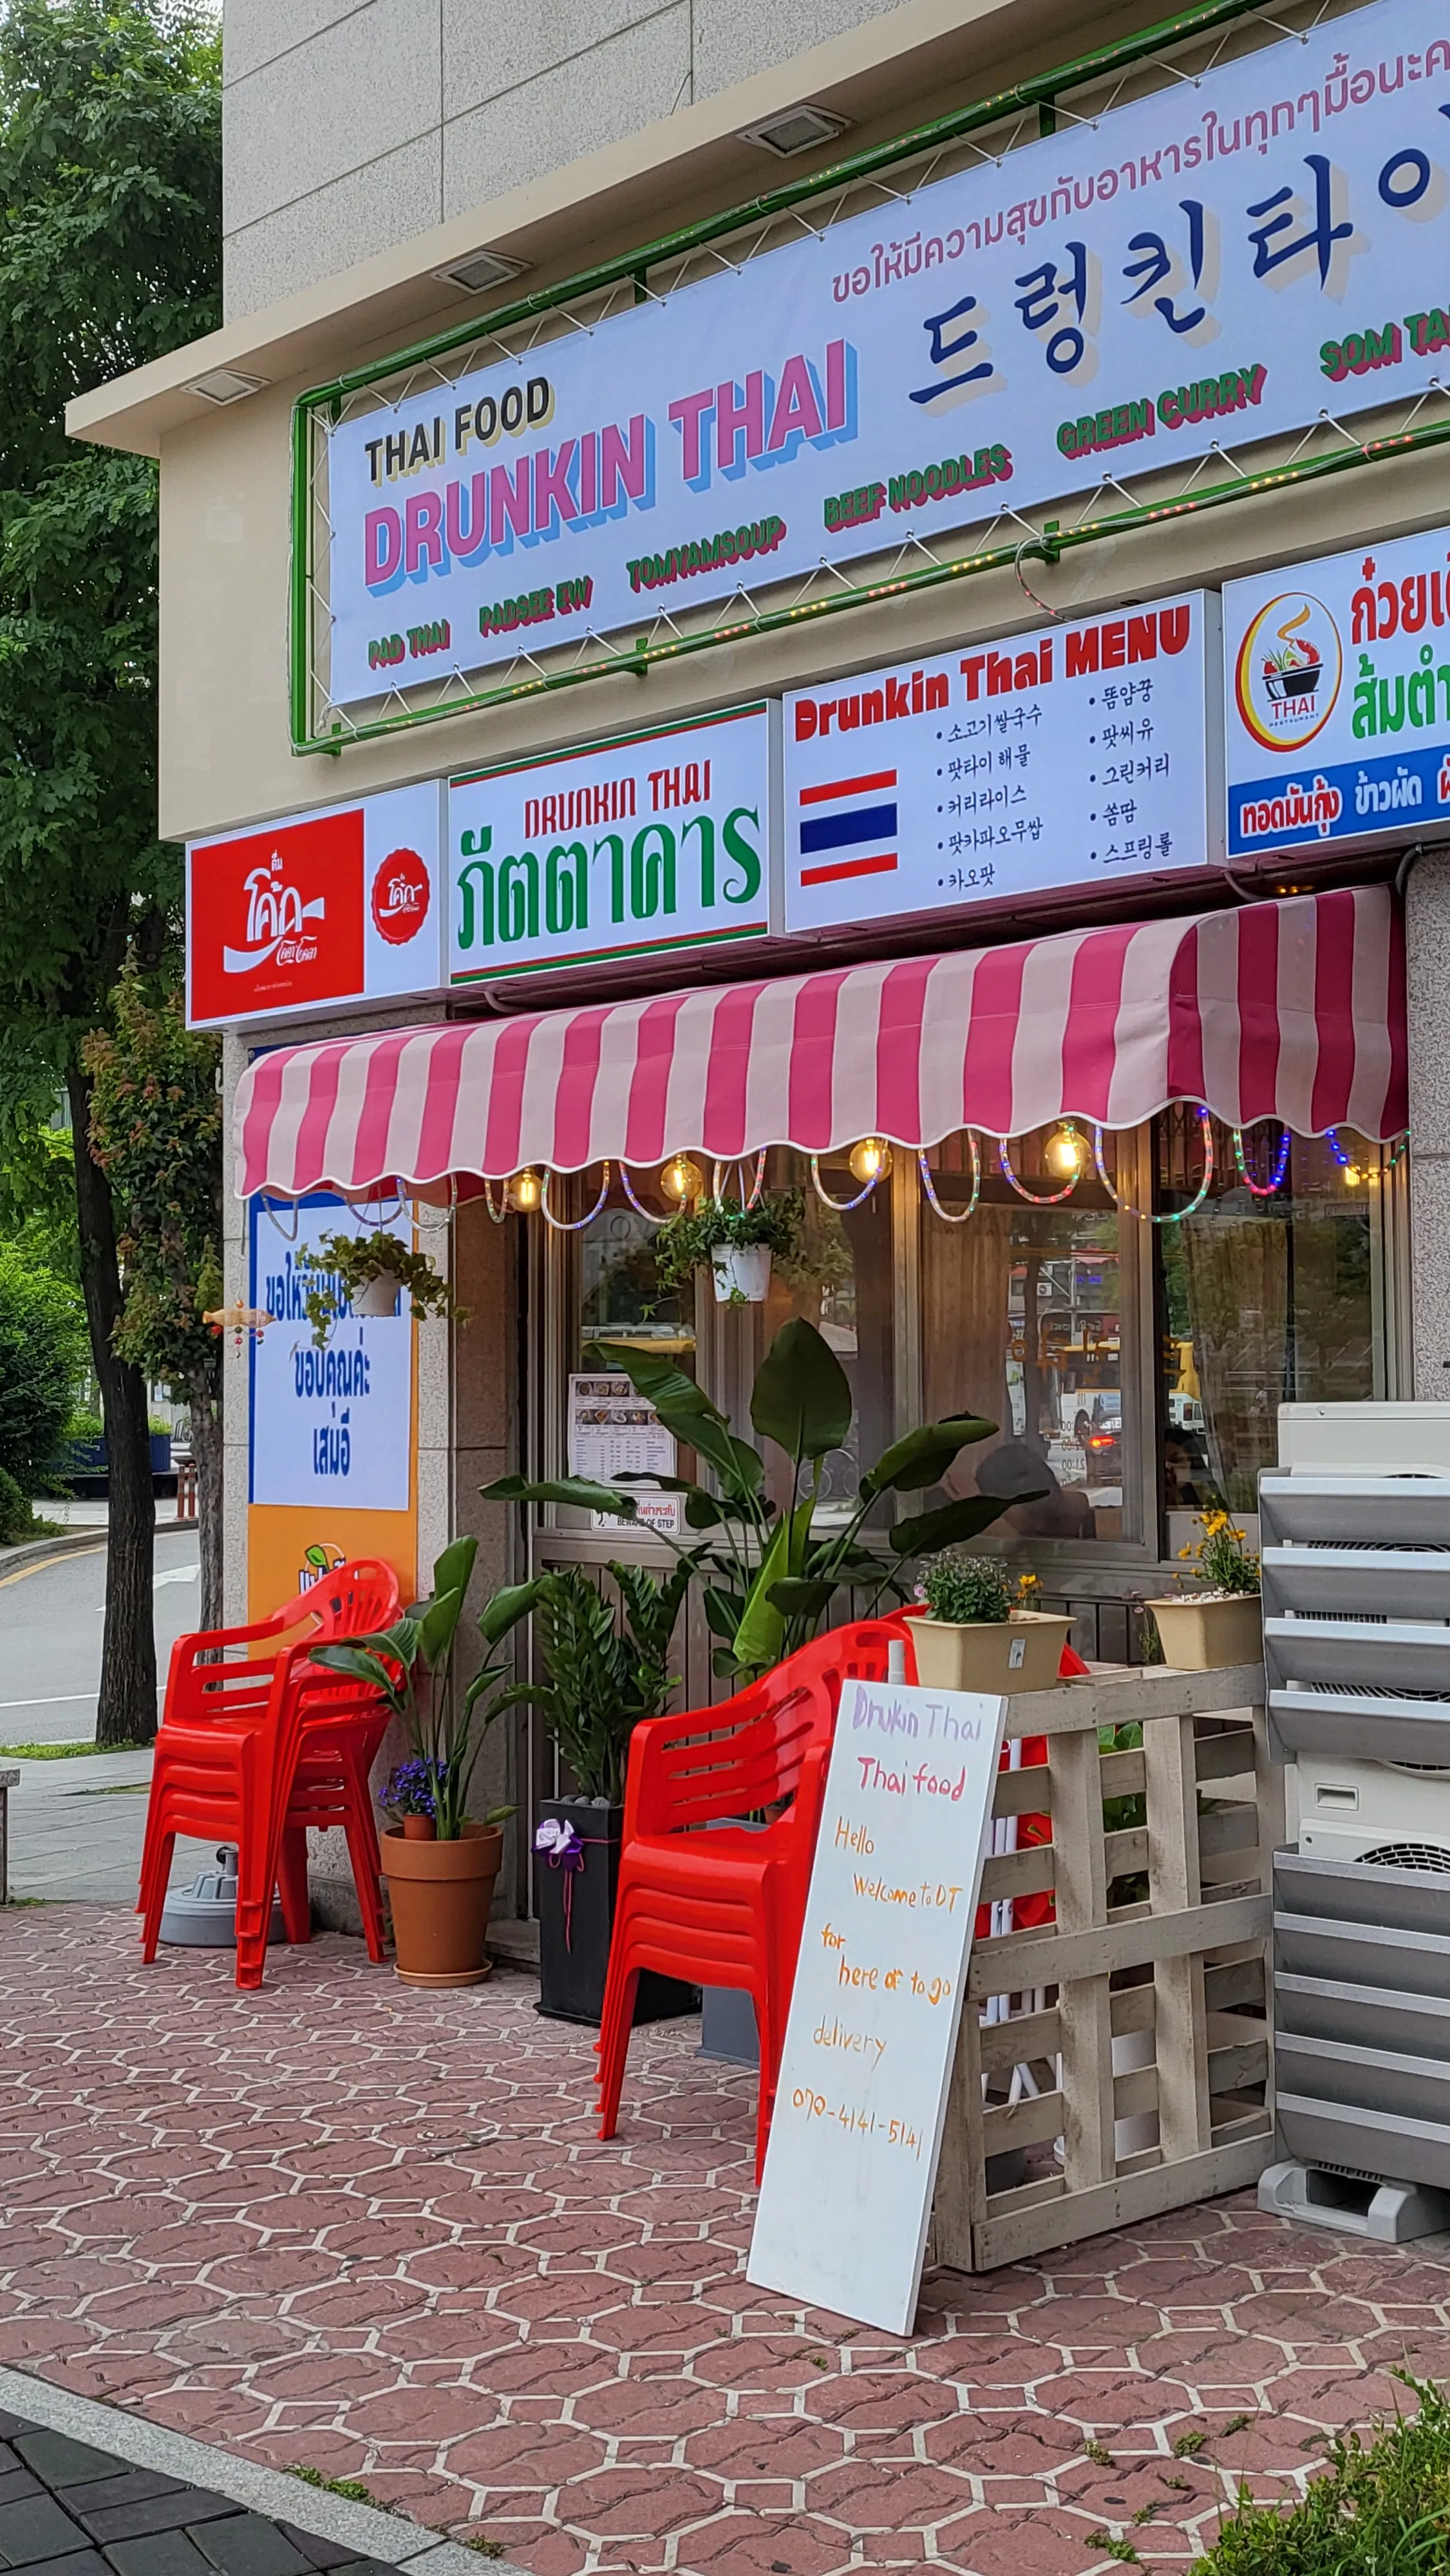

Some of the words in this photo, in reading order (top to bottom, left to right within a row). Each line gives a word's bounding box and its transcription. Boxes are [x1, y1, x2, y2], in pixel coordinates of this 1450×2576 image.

[1319, 322, 1402, 382] SOM
[1403, 305, 1450, 356] TA
[365, 416, 444, 486] THAI
[455, 377, 554, 455] FOOD
[1057, 397, 1155, 460] GREEN
[1157, 363, 1267, 430] CURRY
[365, 414, 655, 596] DRUNKIN
[668, 338, 857, 492] THAI
[824, 482, 886, 533] BEEF
[889, 443, 1013, 513] NOODLES
[626, 515, 786, 593] TOMYAMSOUP
[479, 587, 555, 638] PADSEE
[556, 574, 593, 615] EW
[1352, 551, 1450, 644] ก๋วยเ
[368, 634, 405, 670] PAD
[406, 619, 450, 658] THAI
[795, 670, 950, 742] Drunkin
[960, 638, 1053, 703] Thai
[1066, 605, 1191, 679] MENU
[1102, 678, 1153, 710] 똠얌꿍
[1272, 695, 1315, 719] THAI
[1102, 718, 1154, 750] 팟씨유
[1102, 753, 1169, 785] 그린커리
[525, 777, 636, 839] DRUNKIN
[648, 759, 710, 811] THAI
[948, 785, 1027, 818] 커리라이스
[1103, 799, 1137, 826] 쏨땀
[1243, 777, 1340, 834] ทอดมันกุ้ง
[1355, 766, 1422, 815] ข้าวผัด
[457, 805, 760, 950] ภัตตาคาร
[949, 863, 995, 891] 카오팟
[657, 1519, 675, 1528] STEP
[925, 1703, 983, 1742] Thai
[858, 1757, 909, 1796] Thai
[912, 1763, 966, 1801] food
[835, 1815, 874, 1855] Hello
[854, 1873, 916, 1908] Welcome
[936, 1884, 964, 1915] DT
[822, 1922, 846, 1949] for
[839, 1954, 878, 1990] here
[813, 2014, 887, 2072] delivery
[793, 2087, 923, 2162] 070-4141-5141
